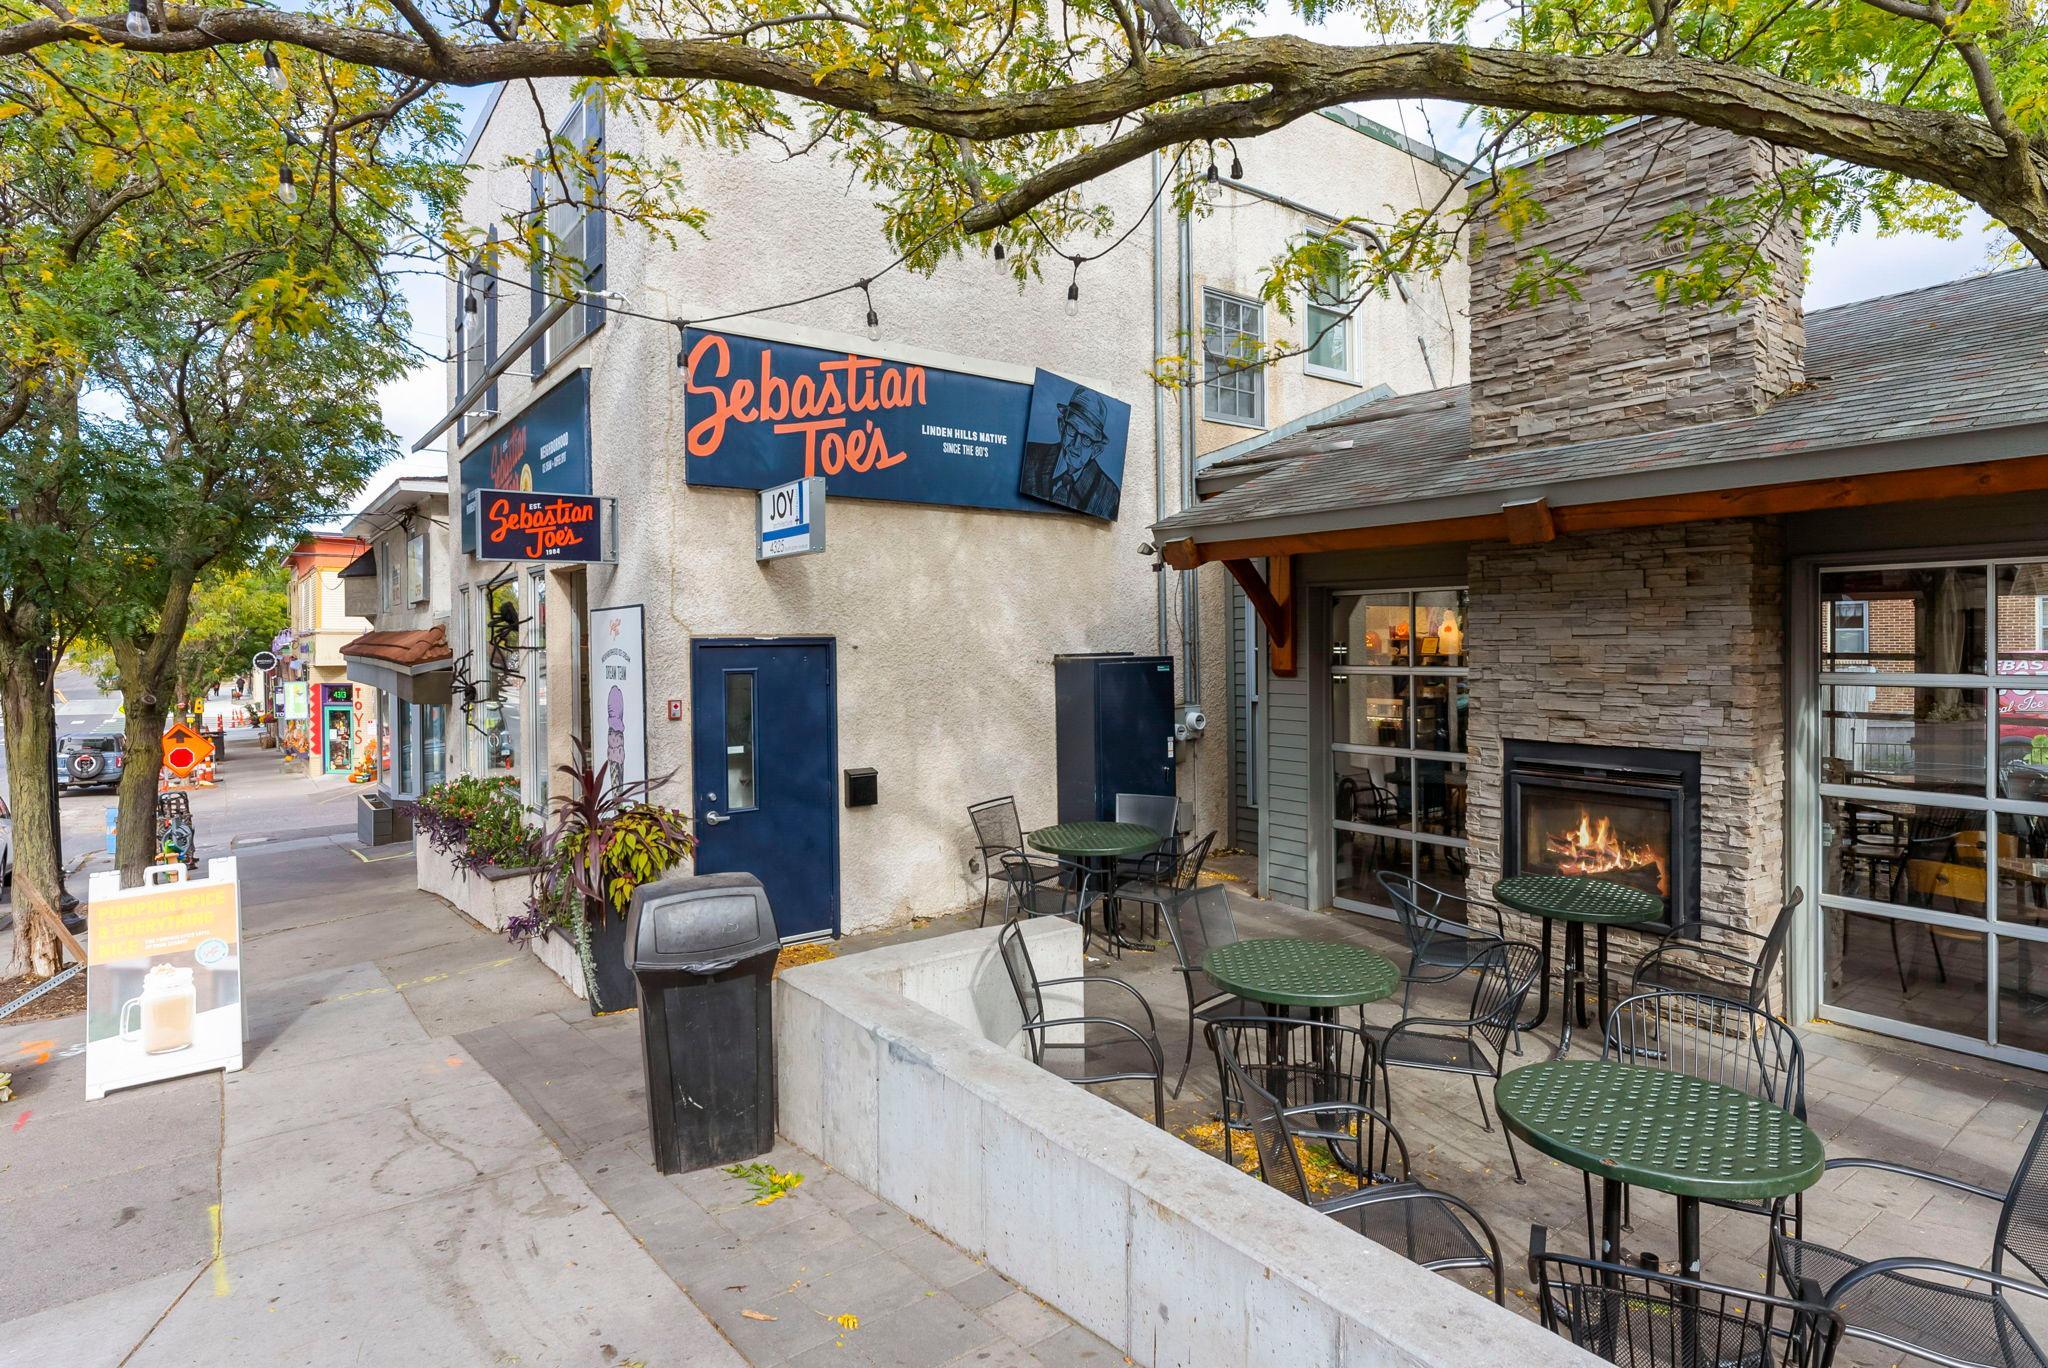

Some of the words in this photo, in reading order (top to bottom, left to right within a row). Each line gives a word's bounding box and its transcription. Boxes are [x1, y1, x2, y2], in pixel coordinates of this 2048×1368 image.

[687, 335, 926, 457] Sebastian
[922, 425, 953, 438] LINDEN
[955, 428, 978, 441] HILLS
[979, 432, 1007, 445] NATIVE
[943, 442, 961, 454] SINCE
[962, 444, 974, 456] THE
[975, 446, 989, 458] 80'S
[489, 498, 593, 543] Sebastian
[770, 489, 794, 521] JOY
[525, 526, 583, 558] Joe's
[545, 548, 561, 556] 1984
[769, 539, 785, 554] 4325
[354, 687, 364, 745] TOYS
[2018, 696, 2044, 711] Ice
[98, 897, 176, 921] PUMPKIN
[179, 890, 225, 909] SPICE
